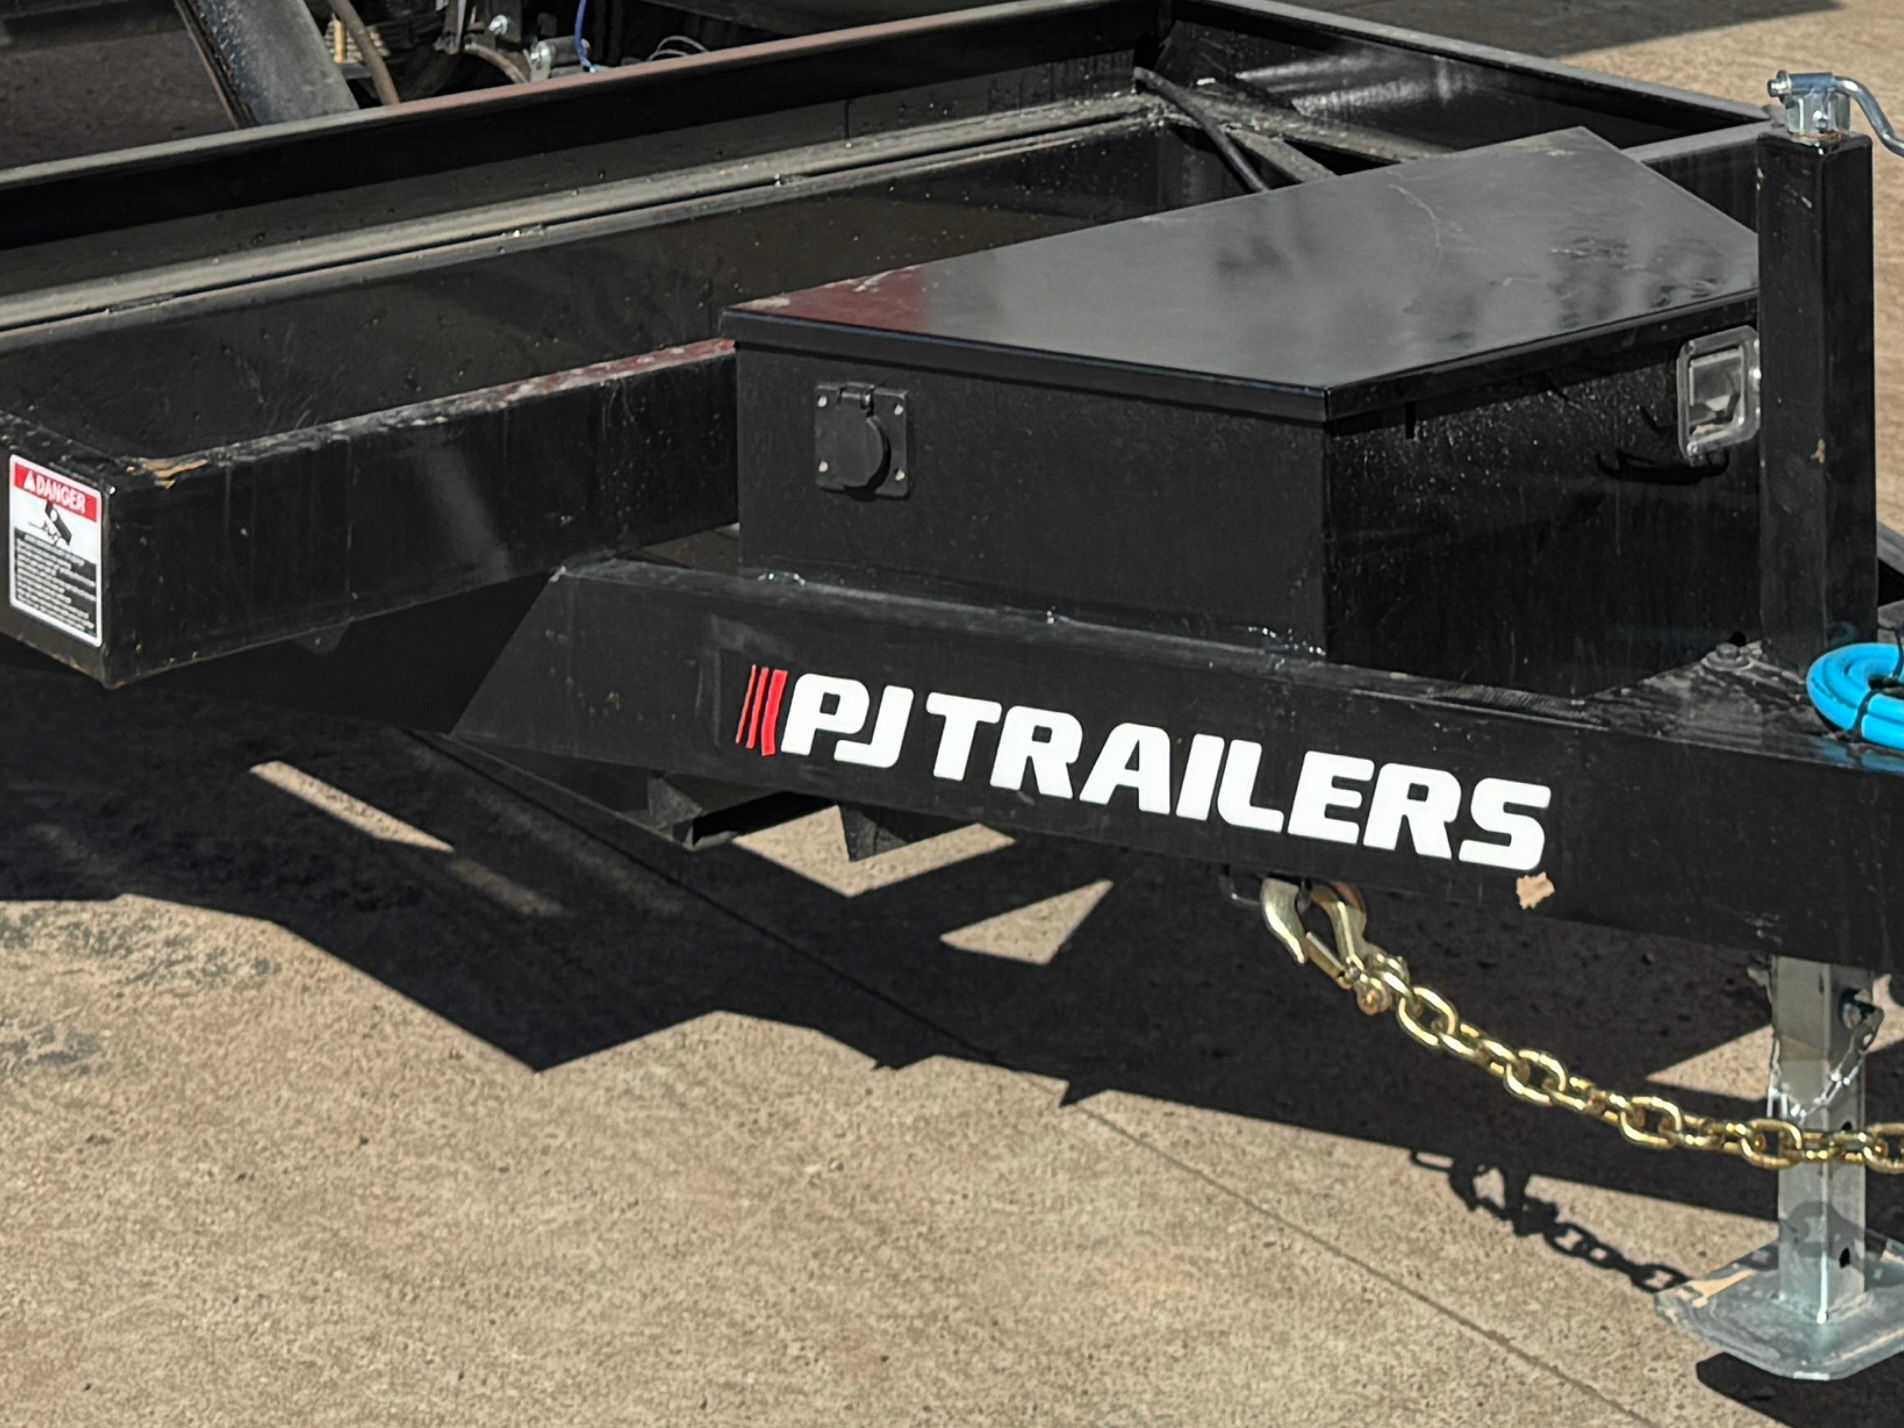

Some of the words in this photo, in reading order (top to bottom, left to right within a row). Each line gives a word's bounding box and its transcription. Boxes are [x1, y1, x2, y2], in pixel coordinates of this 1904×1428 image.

[35, 474, 86, 514] DANGER
[781, 673, 914, 768] PJ
[926, 692, 1552, 871] TRAILERS
